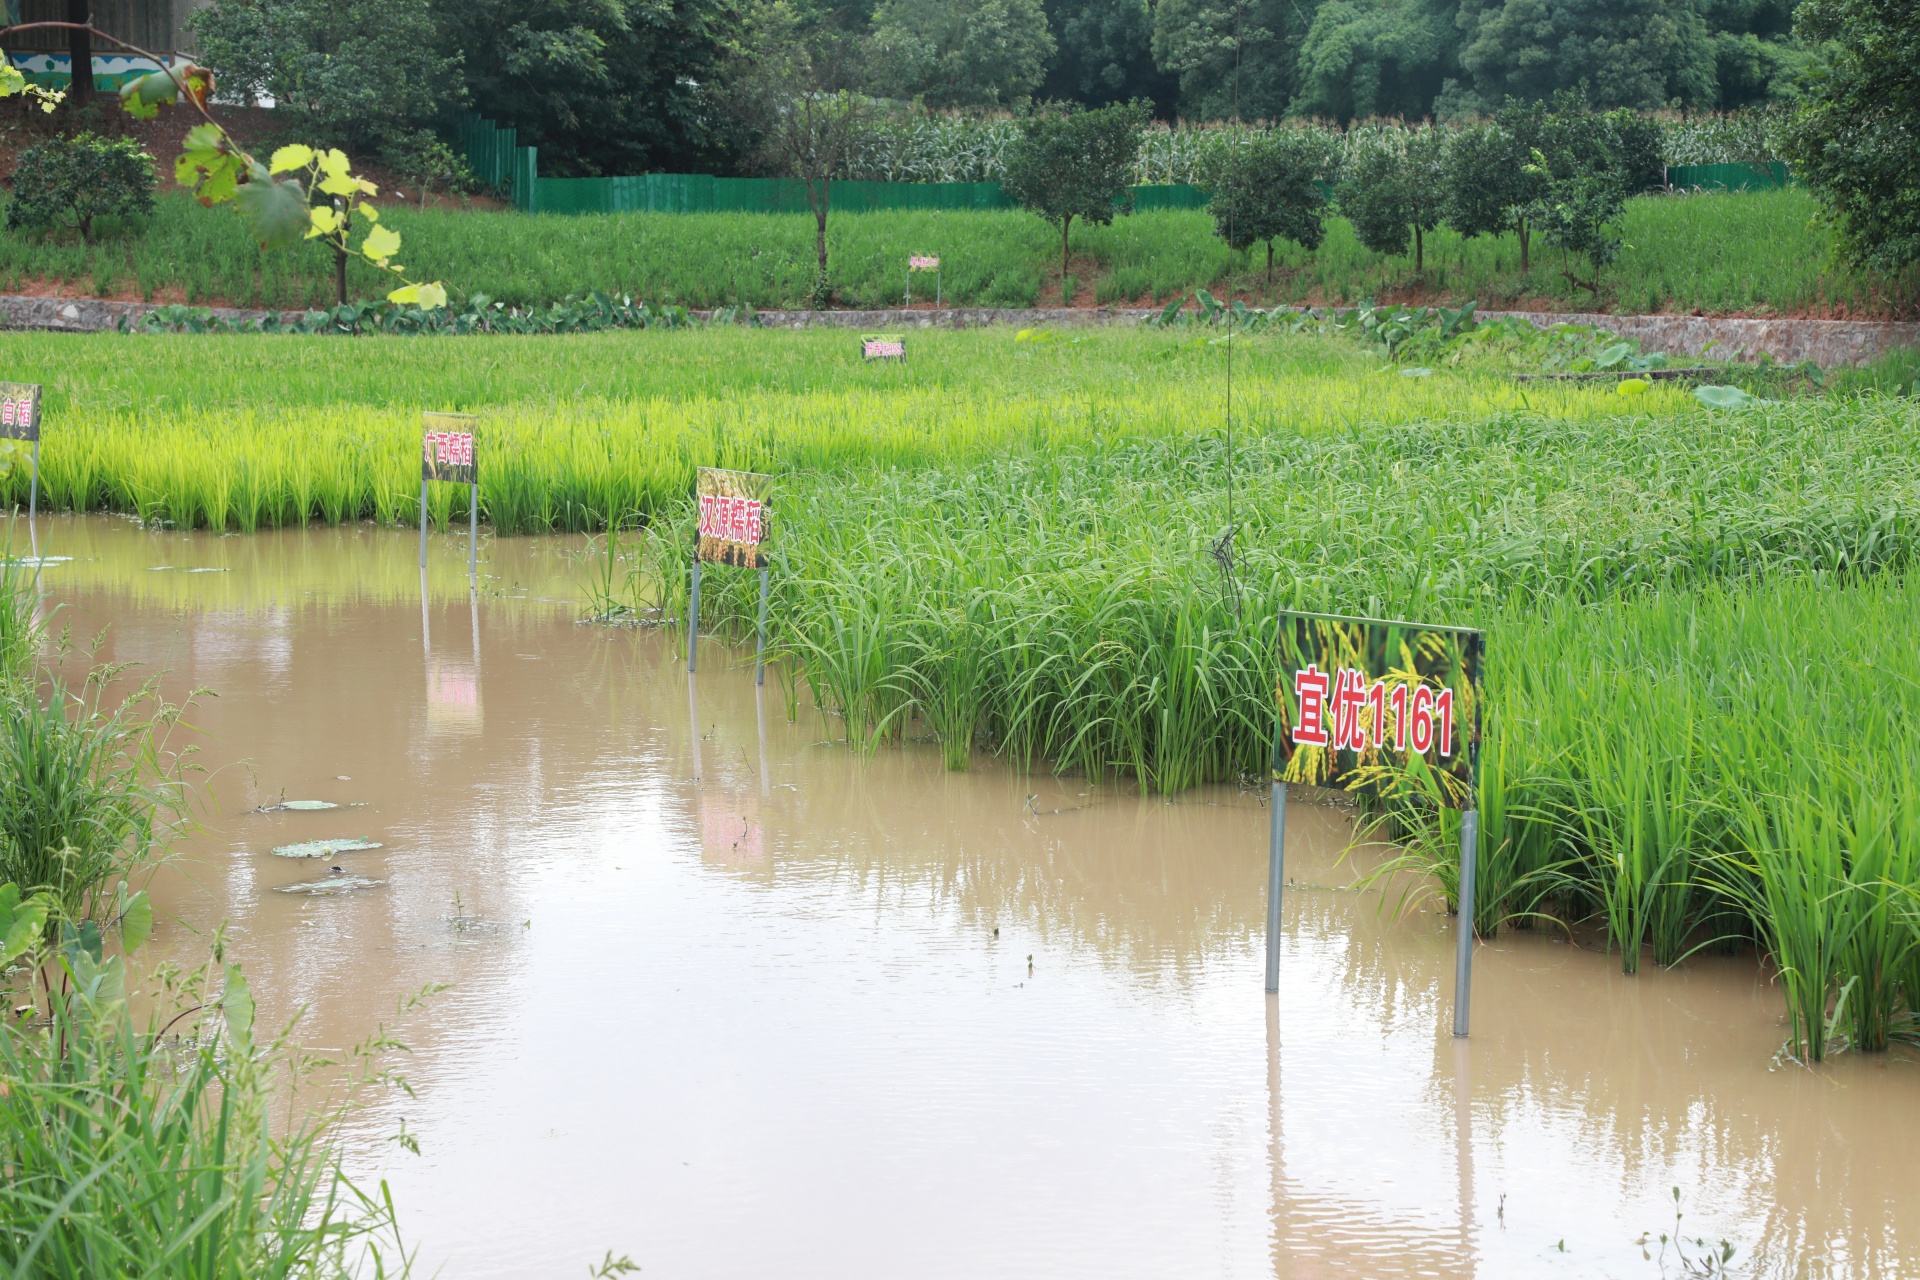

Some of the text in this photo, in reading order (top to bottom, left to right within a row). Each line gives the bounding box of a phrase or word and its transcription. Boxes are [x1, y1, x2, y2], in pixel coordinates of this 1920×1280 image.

[3, 398, 31, 427] 白稻
[425, 430, 472, 466] 广西糯稻
[699, 493, 761, 545] 汉源糯稻
[1292, 664, 1453, 756] 宜优1161
